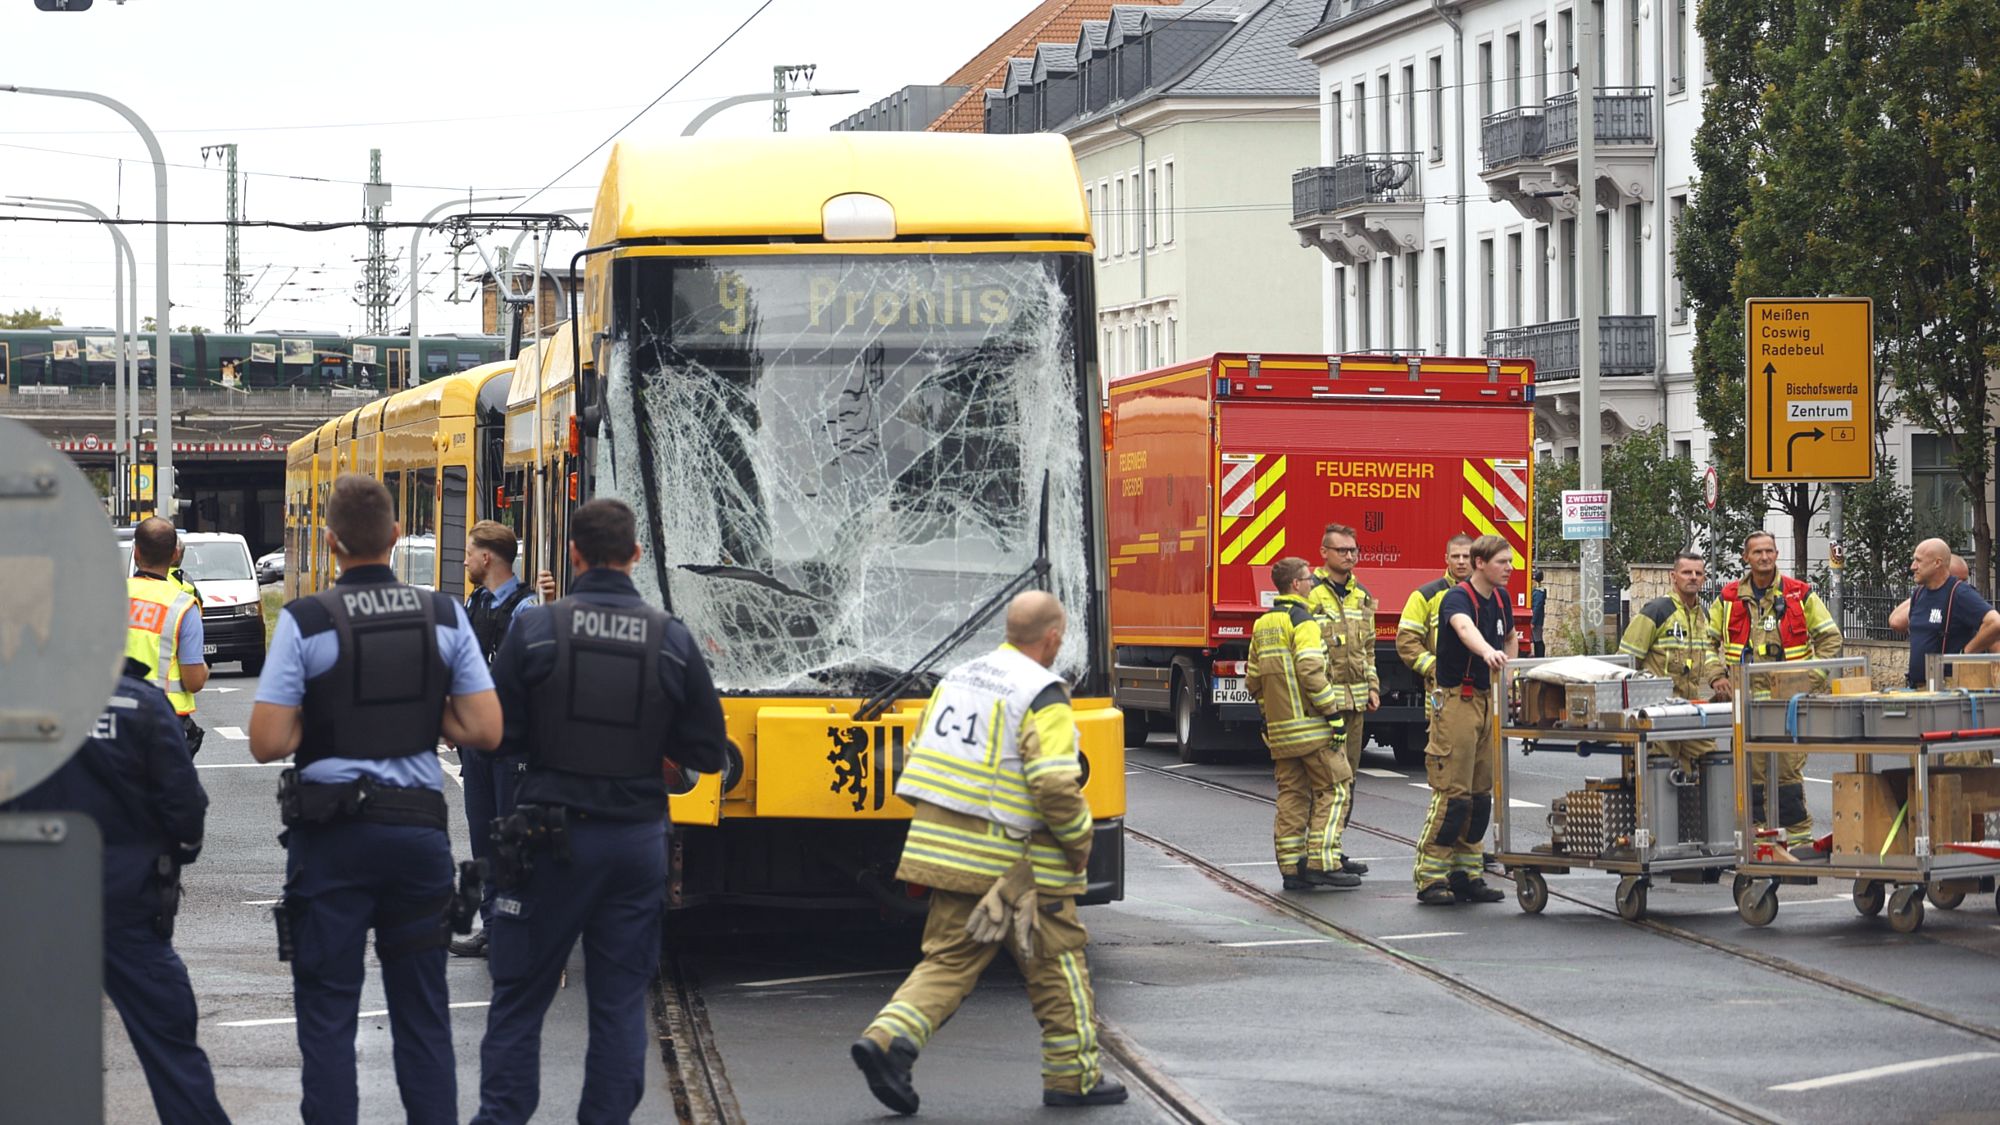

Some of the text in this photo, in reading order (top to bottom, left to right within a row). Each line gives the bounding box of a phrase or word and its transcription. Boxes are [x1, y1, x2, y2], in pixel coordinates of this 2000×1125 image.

[719, 272, 1010, 335] 9 Prohlis
[1761, 308, 1809, 321] Meißen
[1761, 326, 1810, 341] Coswig
[1761, 343, 1825, 356] Radebeul
[1786, 382, 1859, 396] Bischofswerda
[1791, 404, 1849, 418] Zentrum
[1840, 429, 1847, 439] 6
[1315, 460, 1435, 478] FEUERWEHR
[1329, 481, 1421, 498] DRESDEN
[1357, 541, 1400, 553] resden.
[342, 588, 422, 617] POLIZEI
[572, 610, 648, 643] POLIZEI
[1375, 625, 1398, 635] gistik
[1224, 679, 1237, 690] DD
[1215, 690, 1228, 702] FW
[934, 705, 979, 746] C-1
